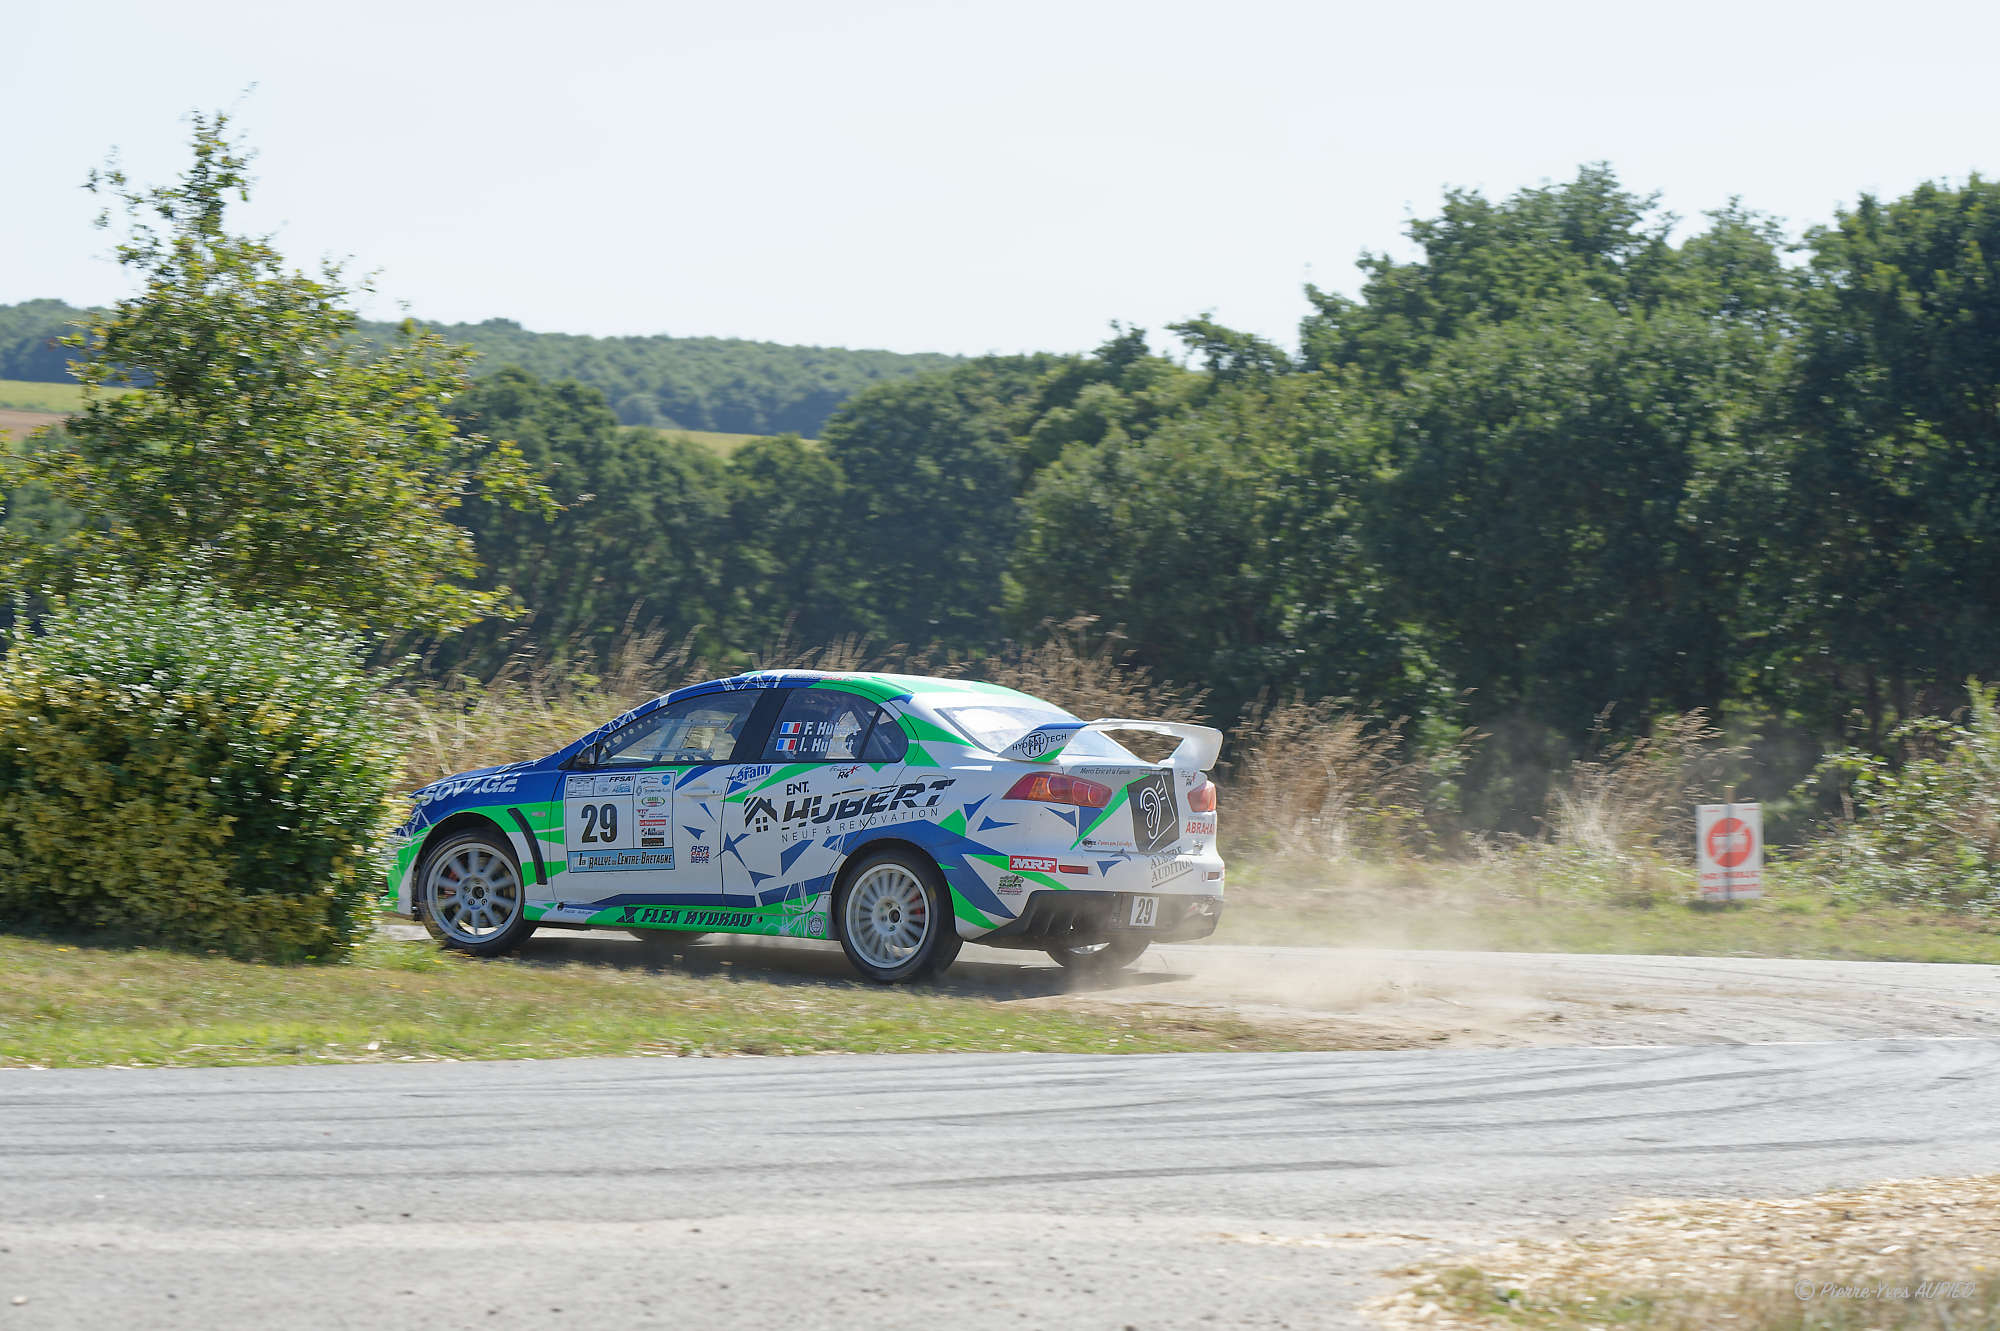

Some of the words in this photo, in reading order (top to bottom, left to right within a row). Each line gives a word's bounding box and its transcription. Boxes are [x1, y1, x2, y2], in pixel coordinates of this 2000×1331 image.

[817, 722, 860, 736] Hubt
[786, 781, 810, 796] ENT.
[581, 803, 618, 843] 29
[781, 828, 817, 843] NEUF
[825, 824, 832, 835] &
[839, 808, 939, 830] RENOVATION
[1185, 821, 1216, 836] ABRAHA
[1011, 857, 1056, 871] MRF
[683, 909, 754, 928] HYDRAU
[1134, 897, 1154, 925] 29
